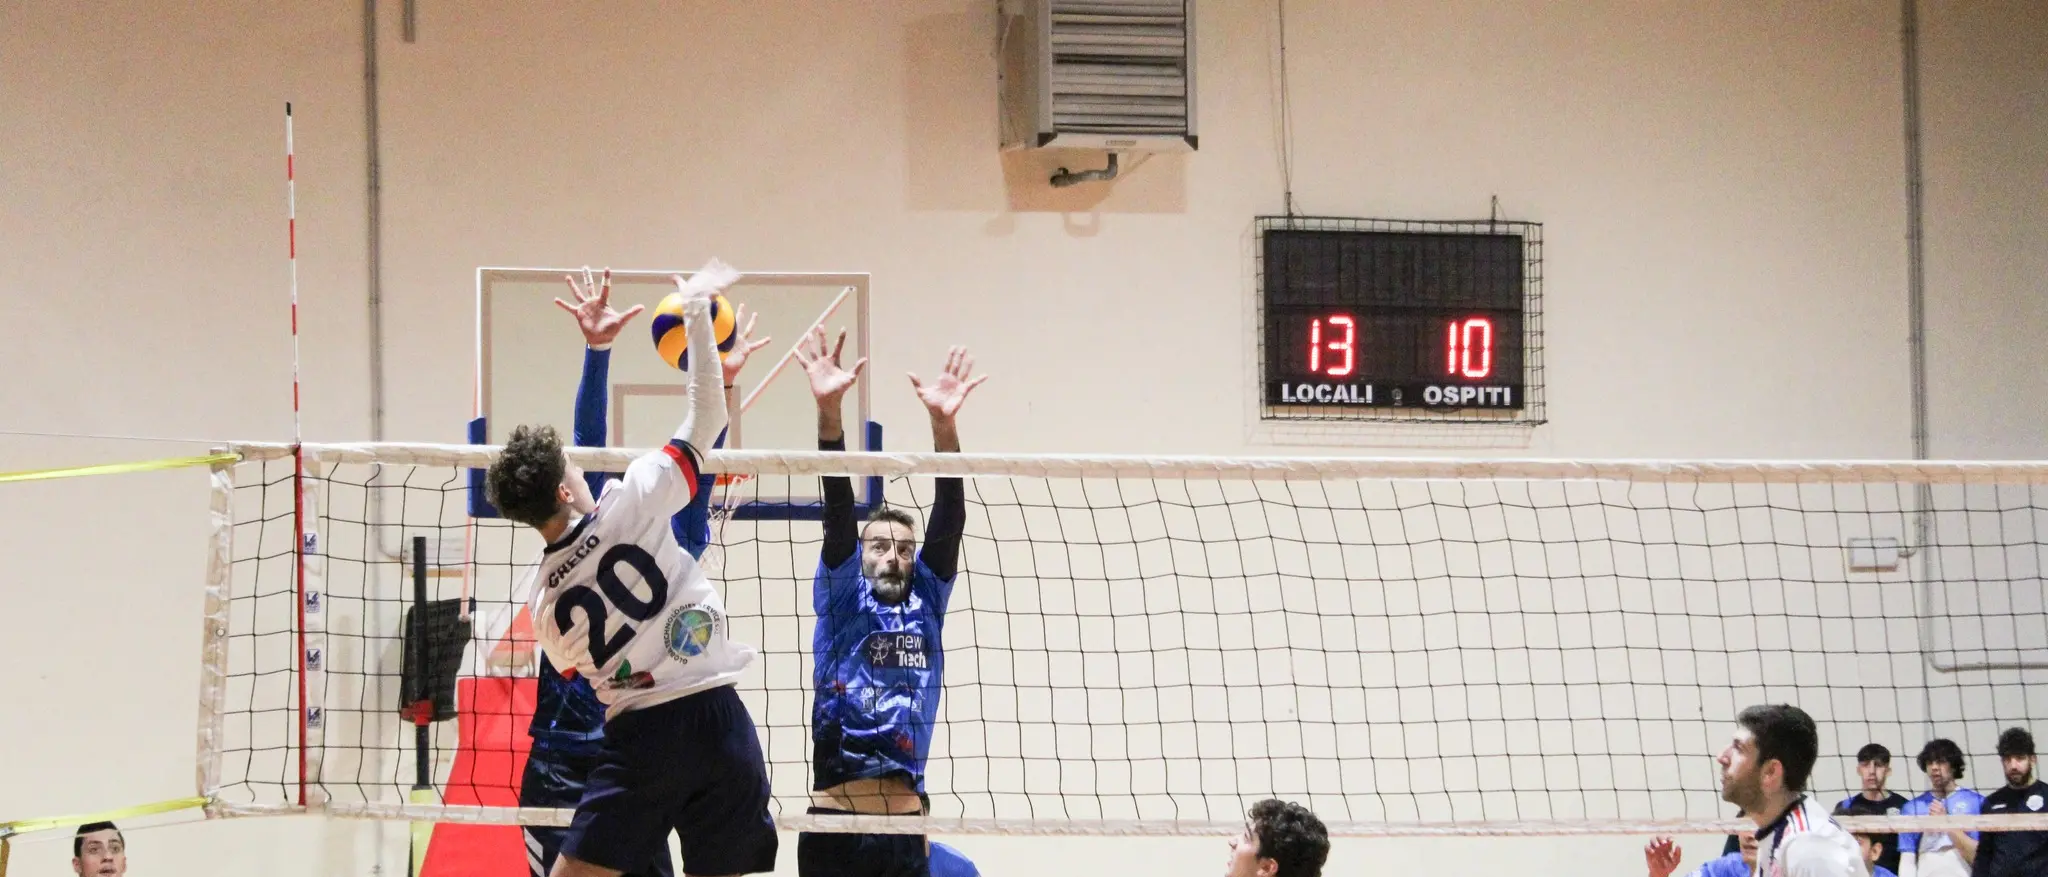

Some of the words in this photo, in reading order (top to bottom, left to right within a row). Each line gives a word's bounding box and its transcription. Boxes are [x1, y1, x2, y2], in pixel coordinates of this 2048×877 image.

[1309, 315, 1355, 376] 13
[1447, 318, 1492, 378] 10
[1281, 383, 1374, 404] LOCALI
[1423, 385, 1512, 406] OSPITI
[548, 534, 601, 589] GRECO
[554, 543, 669, 671] 20
[895, 635, 923, 649] new
[895, 650, 927, 669] Tech
